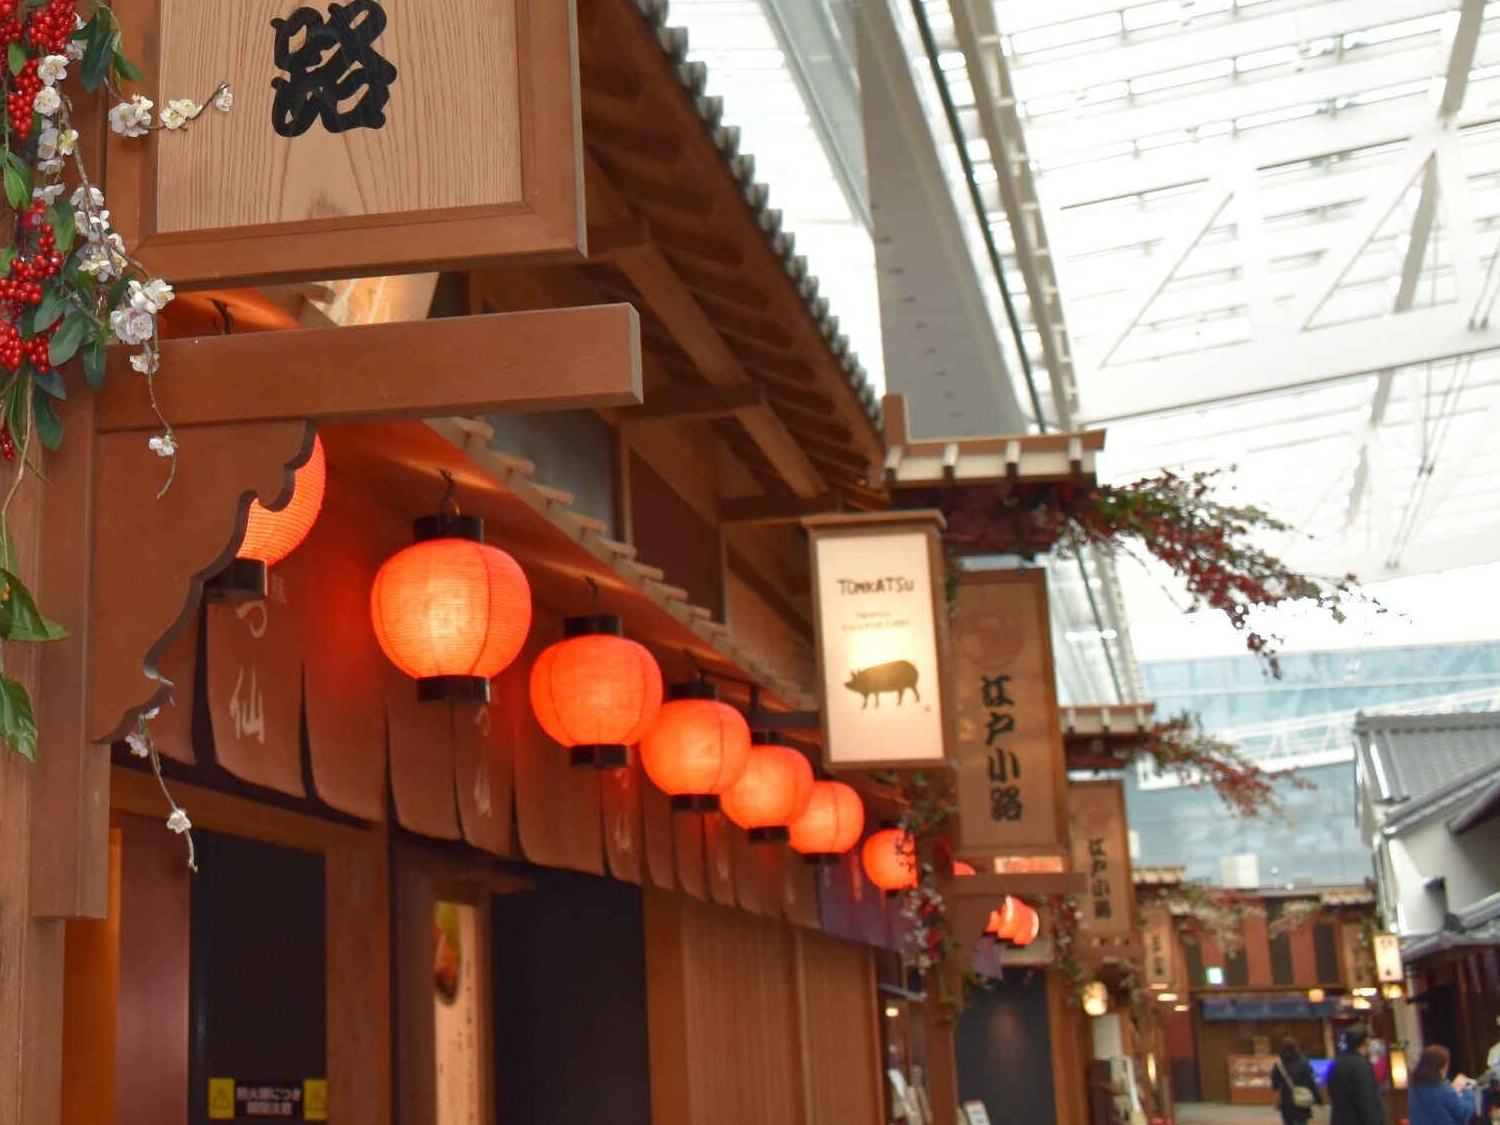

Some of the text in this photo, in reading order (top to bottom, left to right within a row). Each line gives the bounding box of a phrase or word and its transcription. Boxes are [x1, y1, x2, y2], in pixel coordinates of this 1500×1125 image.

[837, 576, 915, 596] TONKATSU
[982, 675, 1023, 822] 江戸小路
